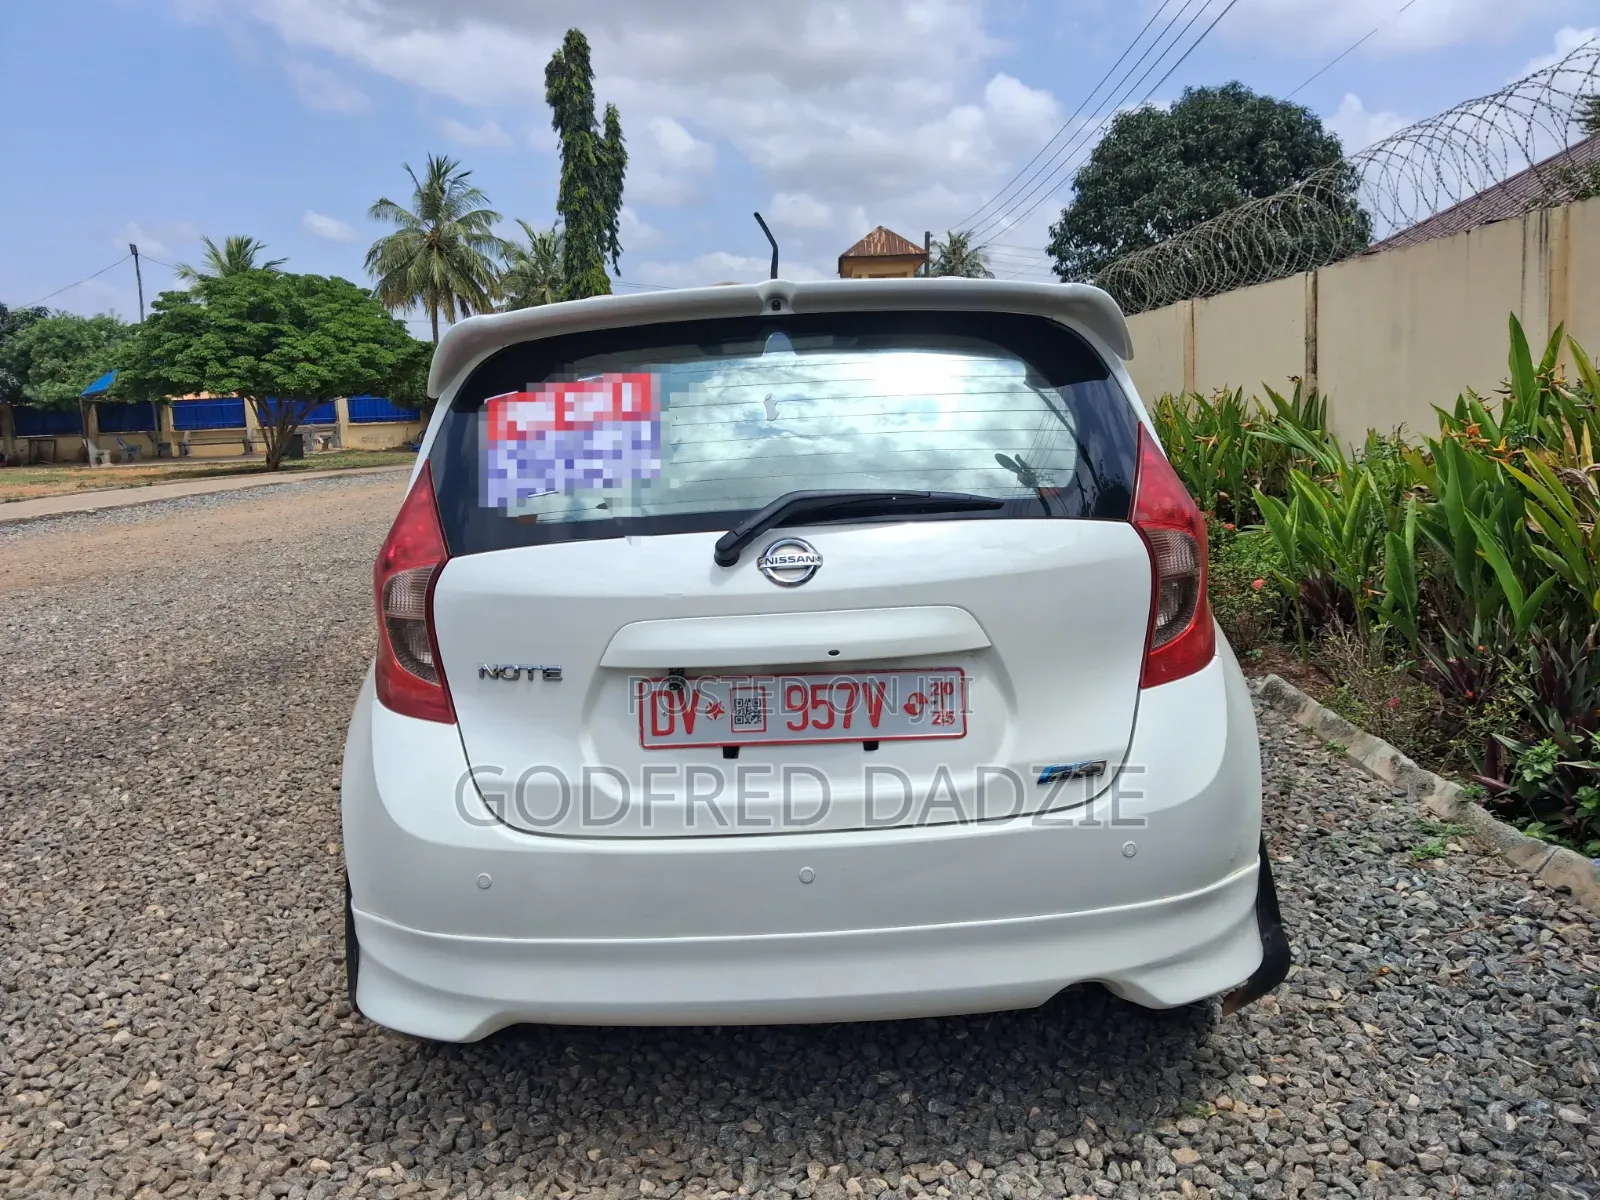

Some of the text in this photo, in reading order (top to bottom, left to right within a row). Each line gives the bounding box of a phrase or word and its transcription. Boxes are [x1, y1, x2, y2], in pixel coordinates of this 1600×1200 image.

[765, 555, 815, 566] NISSAN
[478, 663, 563, 681] NOTE
[651, 682, 886, 736] DV 957V
